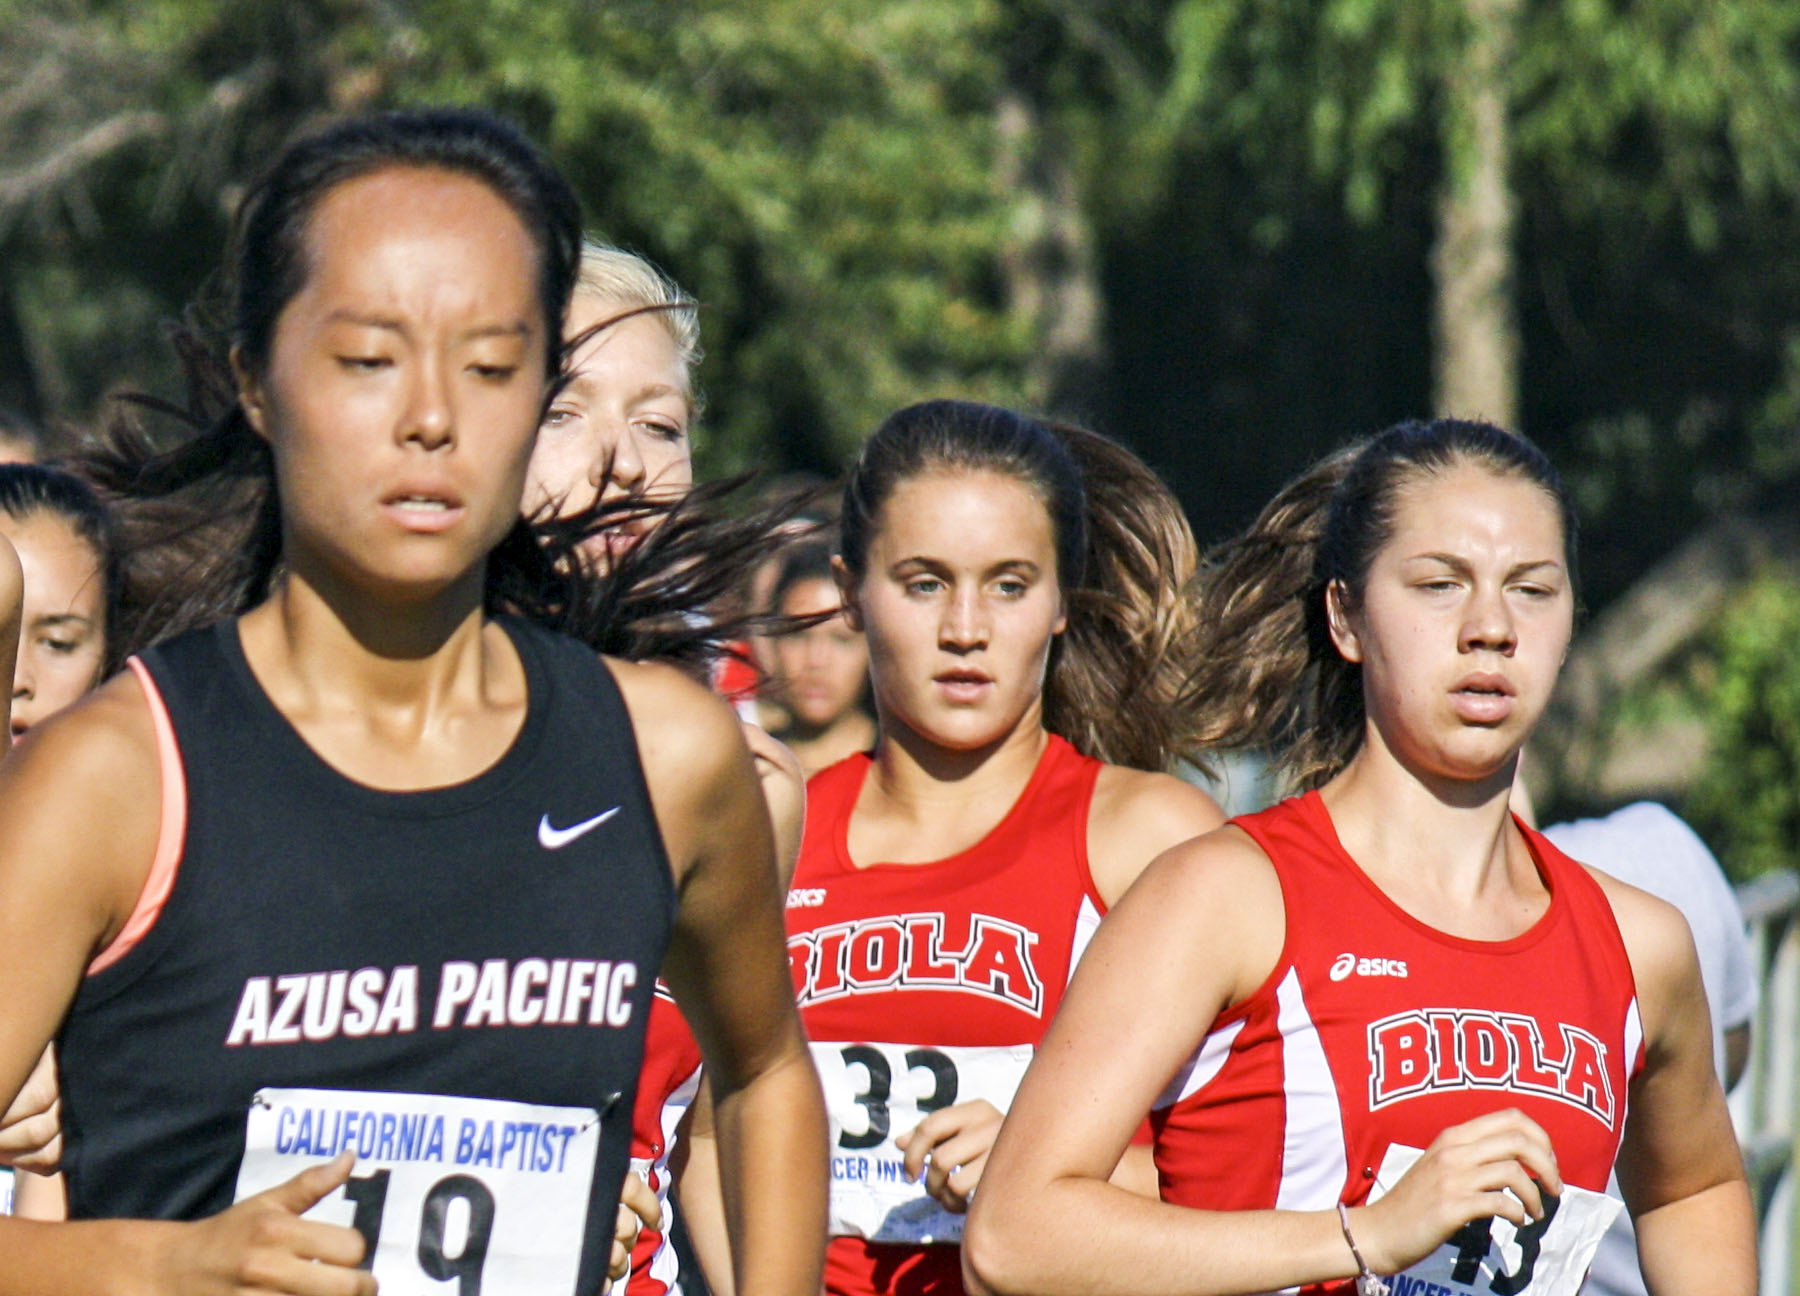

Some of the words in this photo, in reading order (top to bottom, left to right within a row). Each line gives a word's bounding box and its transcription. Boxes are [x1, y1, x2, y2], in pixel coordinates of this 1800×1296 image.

[224, 964, 419, 1047] AZUSA
[431, 956, 638, 1031] PACIFIC
[1356, 957, 1408, 978] asics
[838, 1044, 959, 1150] 33
[1366, 1007, 1615, 1132] BIOLA
[275, 1106, 445, 1162] CALIFORNIA
[455, 1117, 576, 1173] BAPTIST
